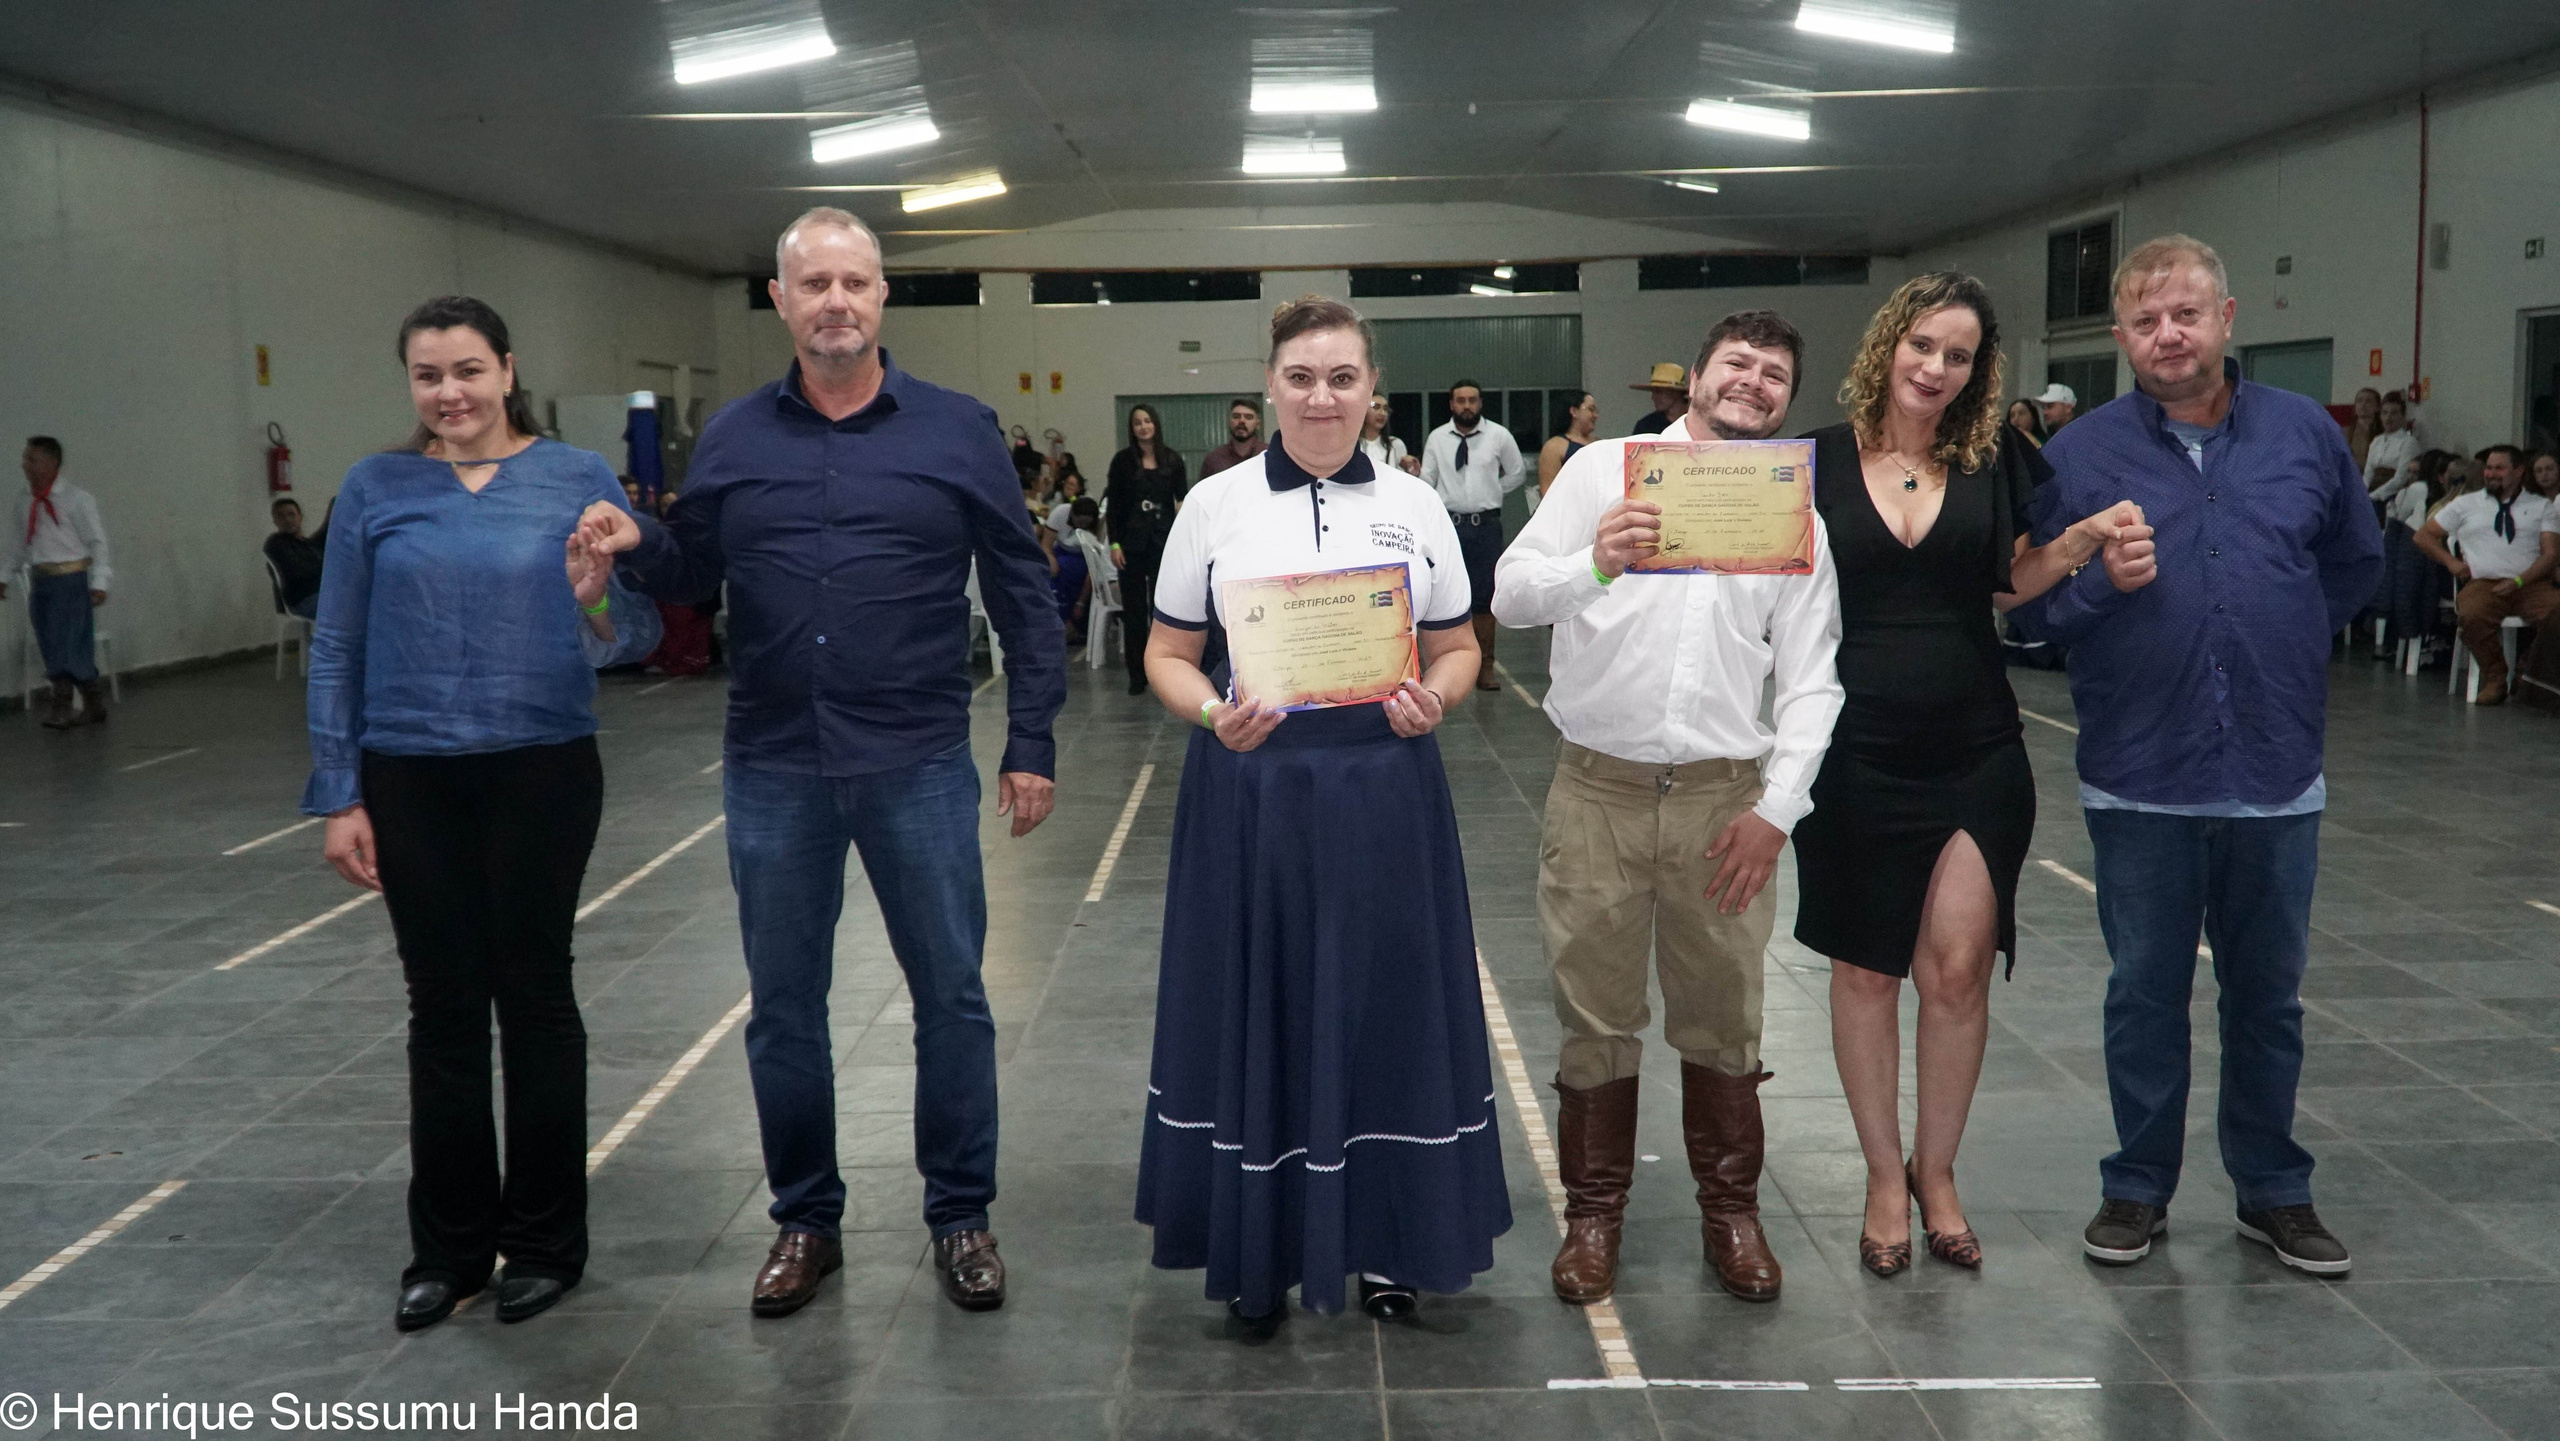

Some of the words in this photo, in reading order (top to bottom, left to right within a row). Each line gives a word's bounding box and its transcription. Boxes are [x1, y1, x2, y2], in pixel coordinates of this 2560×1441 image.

[1683, 466, 1757, 476] CERTIFICADO
[1371, 529, 1415, 546] INOVAÇÃO
[1372, 538, 1416, 556] CAMPEIRA
[1283, 594, 1356, 610] CERTIFICADO
